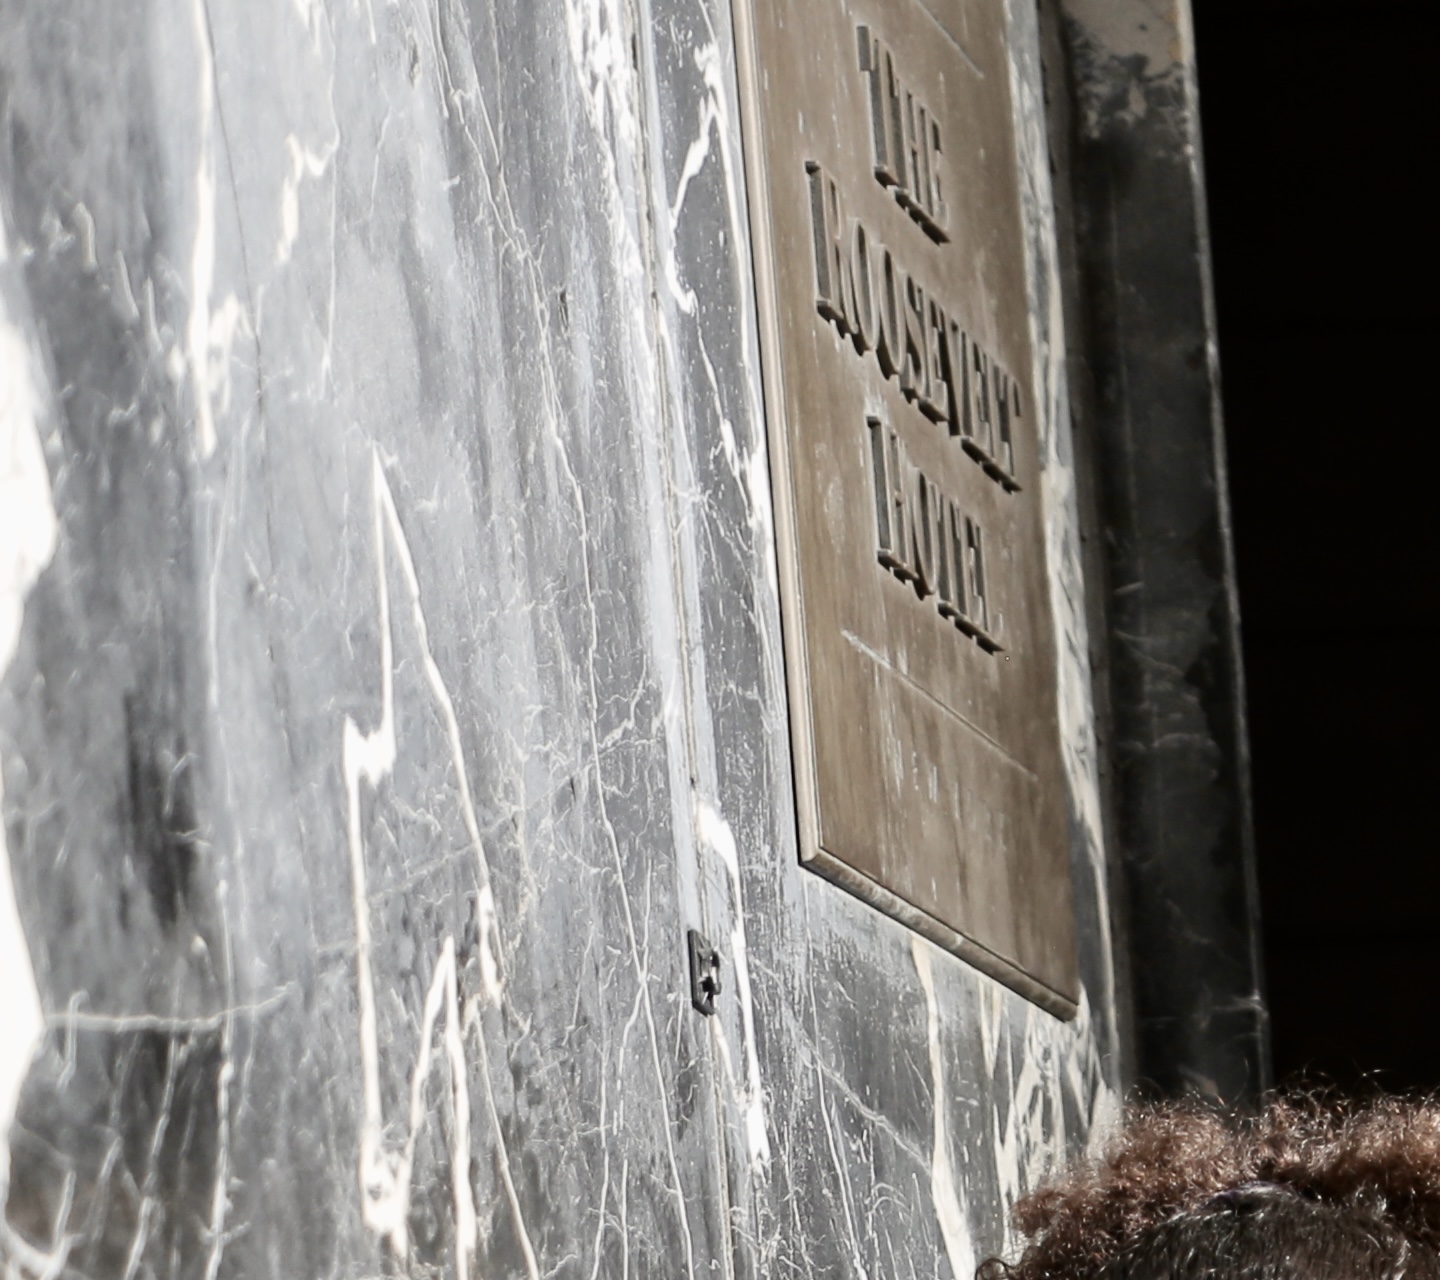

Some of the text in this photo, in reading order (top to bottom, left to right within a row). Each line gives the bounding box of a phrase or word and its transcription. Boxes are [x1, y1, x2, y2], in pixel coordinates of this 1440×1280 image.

[855, 25, 950, 244] THE
[804, 160, 1022, 494] ROOSEVELT
[866, 415, 1004, 655] HOTEL
